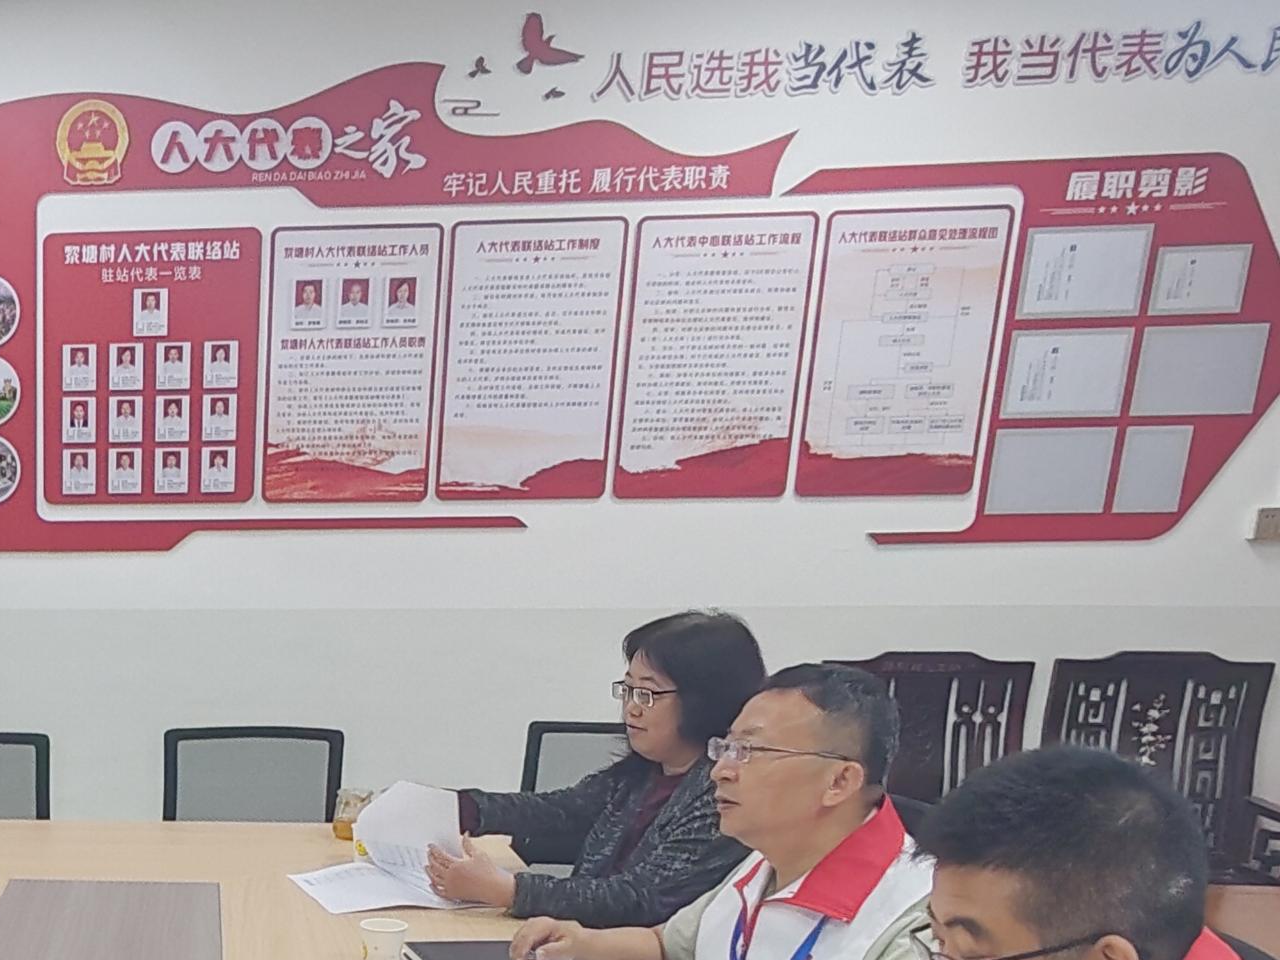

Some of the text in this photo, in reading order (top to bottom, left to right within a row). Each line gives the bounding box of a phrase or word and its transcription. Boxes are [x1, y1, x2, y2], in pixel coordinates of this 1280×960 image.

[596, 31, 934, 98] 人民选我当代表
[154, 100, 427, 178] 人大代表之家
[442, 163, 730, 198] 牢记人民重托 履行代表职责
[1065, 166, 1209, 202] 履职剪影
[475, 237, 601, 254] 人大代表联络站工作制度
[100, 264, 202, 284] 驻站代表一览表
